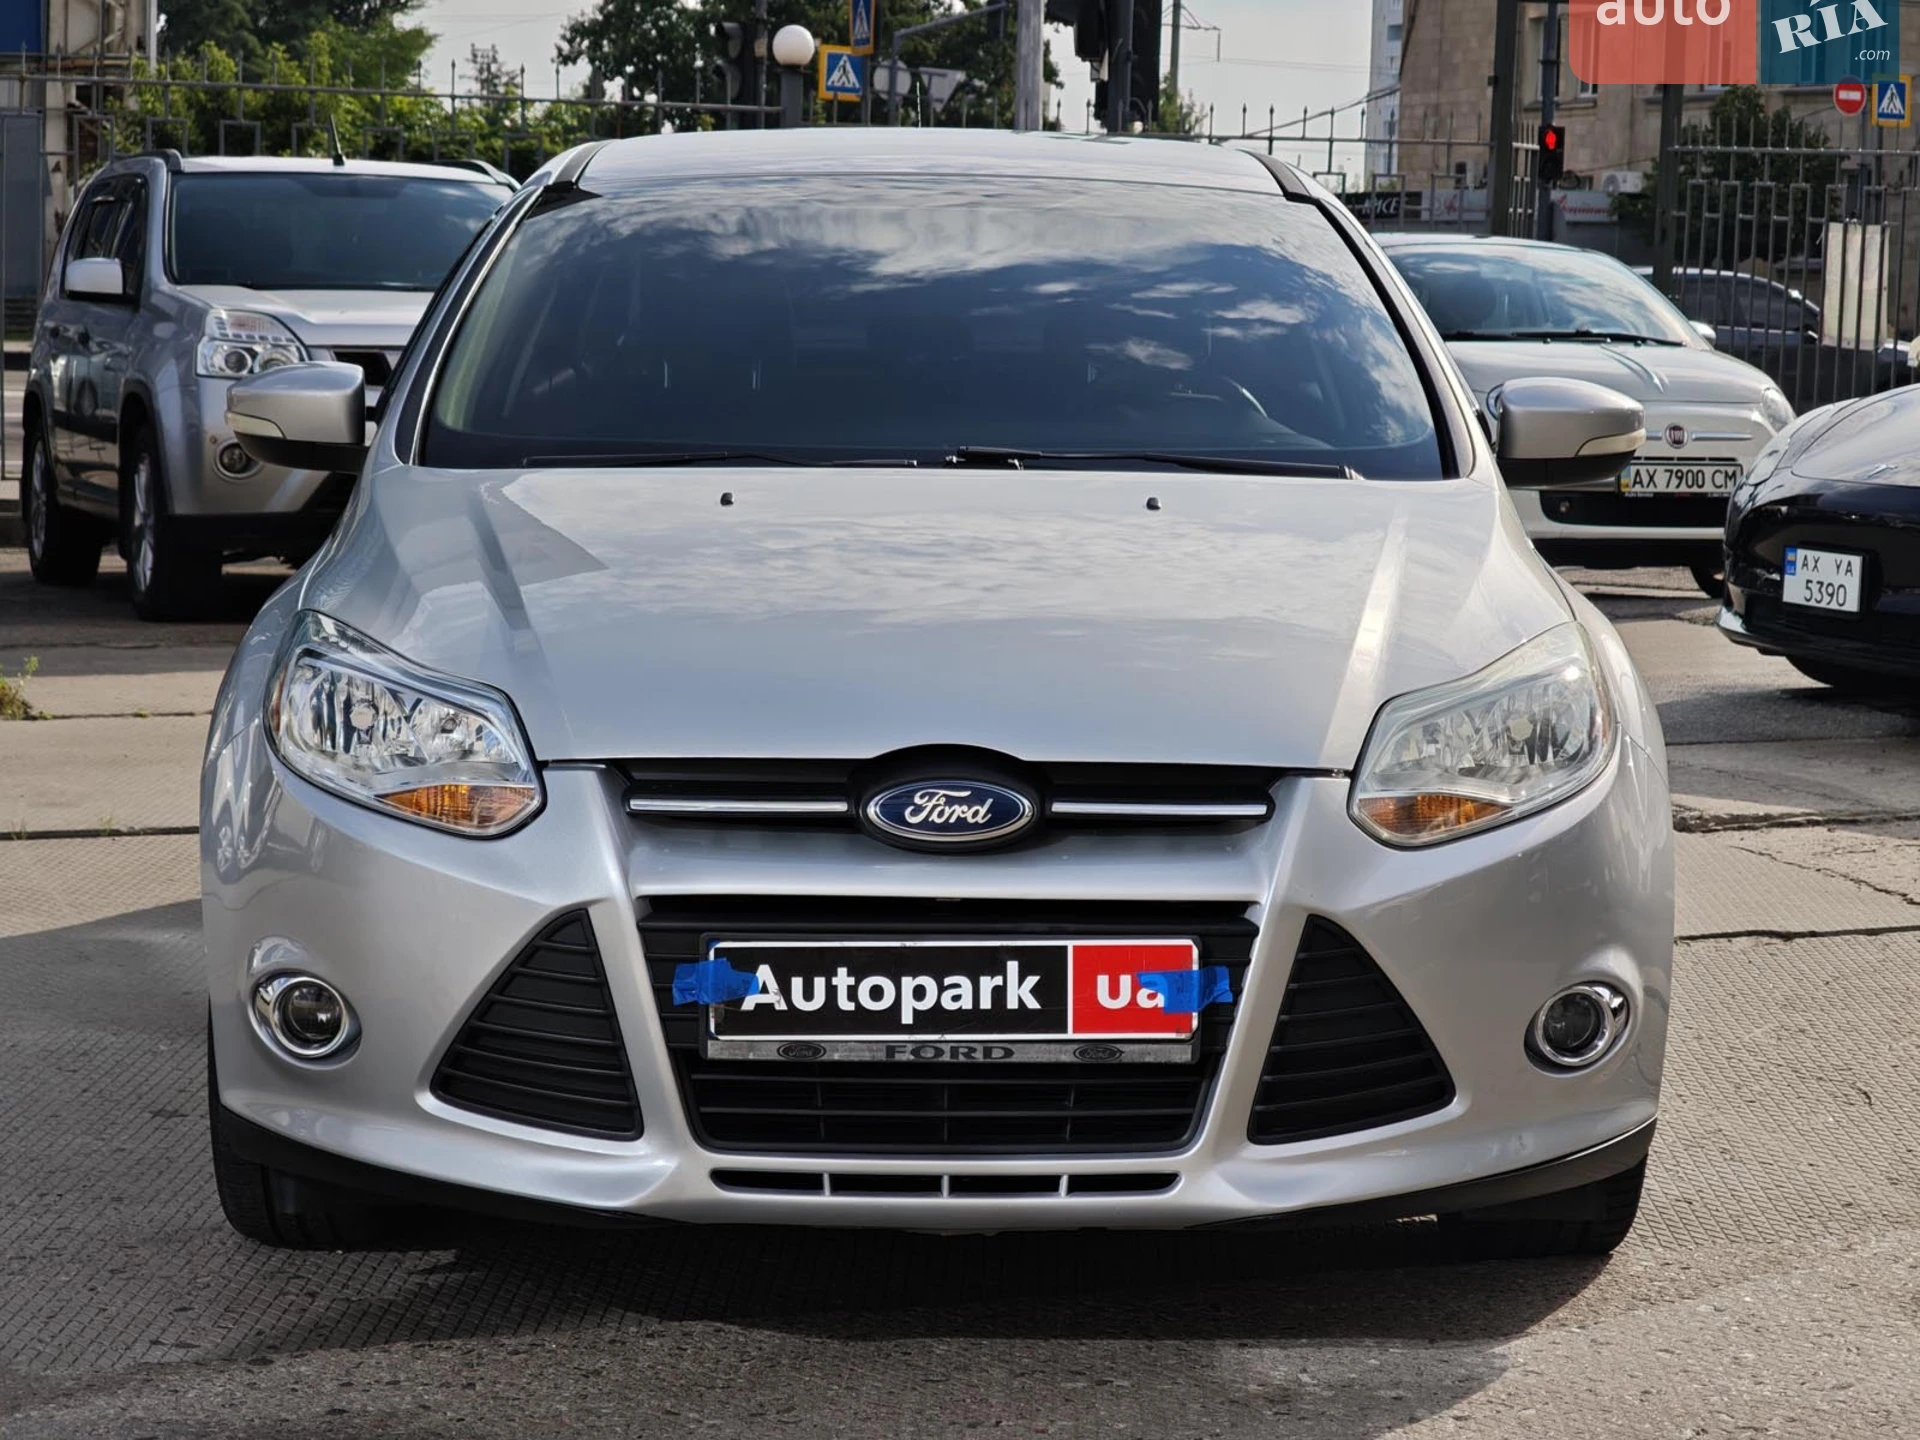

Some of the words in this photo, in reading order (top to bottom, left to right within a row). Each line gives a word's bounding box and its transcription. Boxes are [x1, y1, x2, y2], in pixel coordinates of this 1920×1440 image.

[1632, 468, 1658, 489] AX
[1664, 469, 1706, 489] 7900
[1711, 469, 1737, 489] CM
[1801, 554, 1820, 573] AX
[1834, 558, 1853, 577] YA
[1804, 578, 1847, 607] 5390
[904, 789, 993, 824] Ford
[740, 961, 1041, 1024] Autopark
[885, 1044, 1015, 1060] FORD
